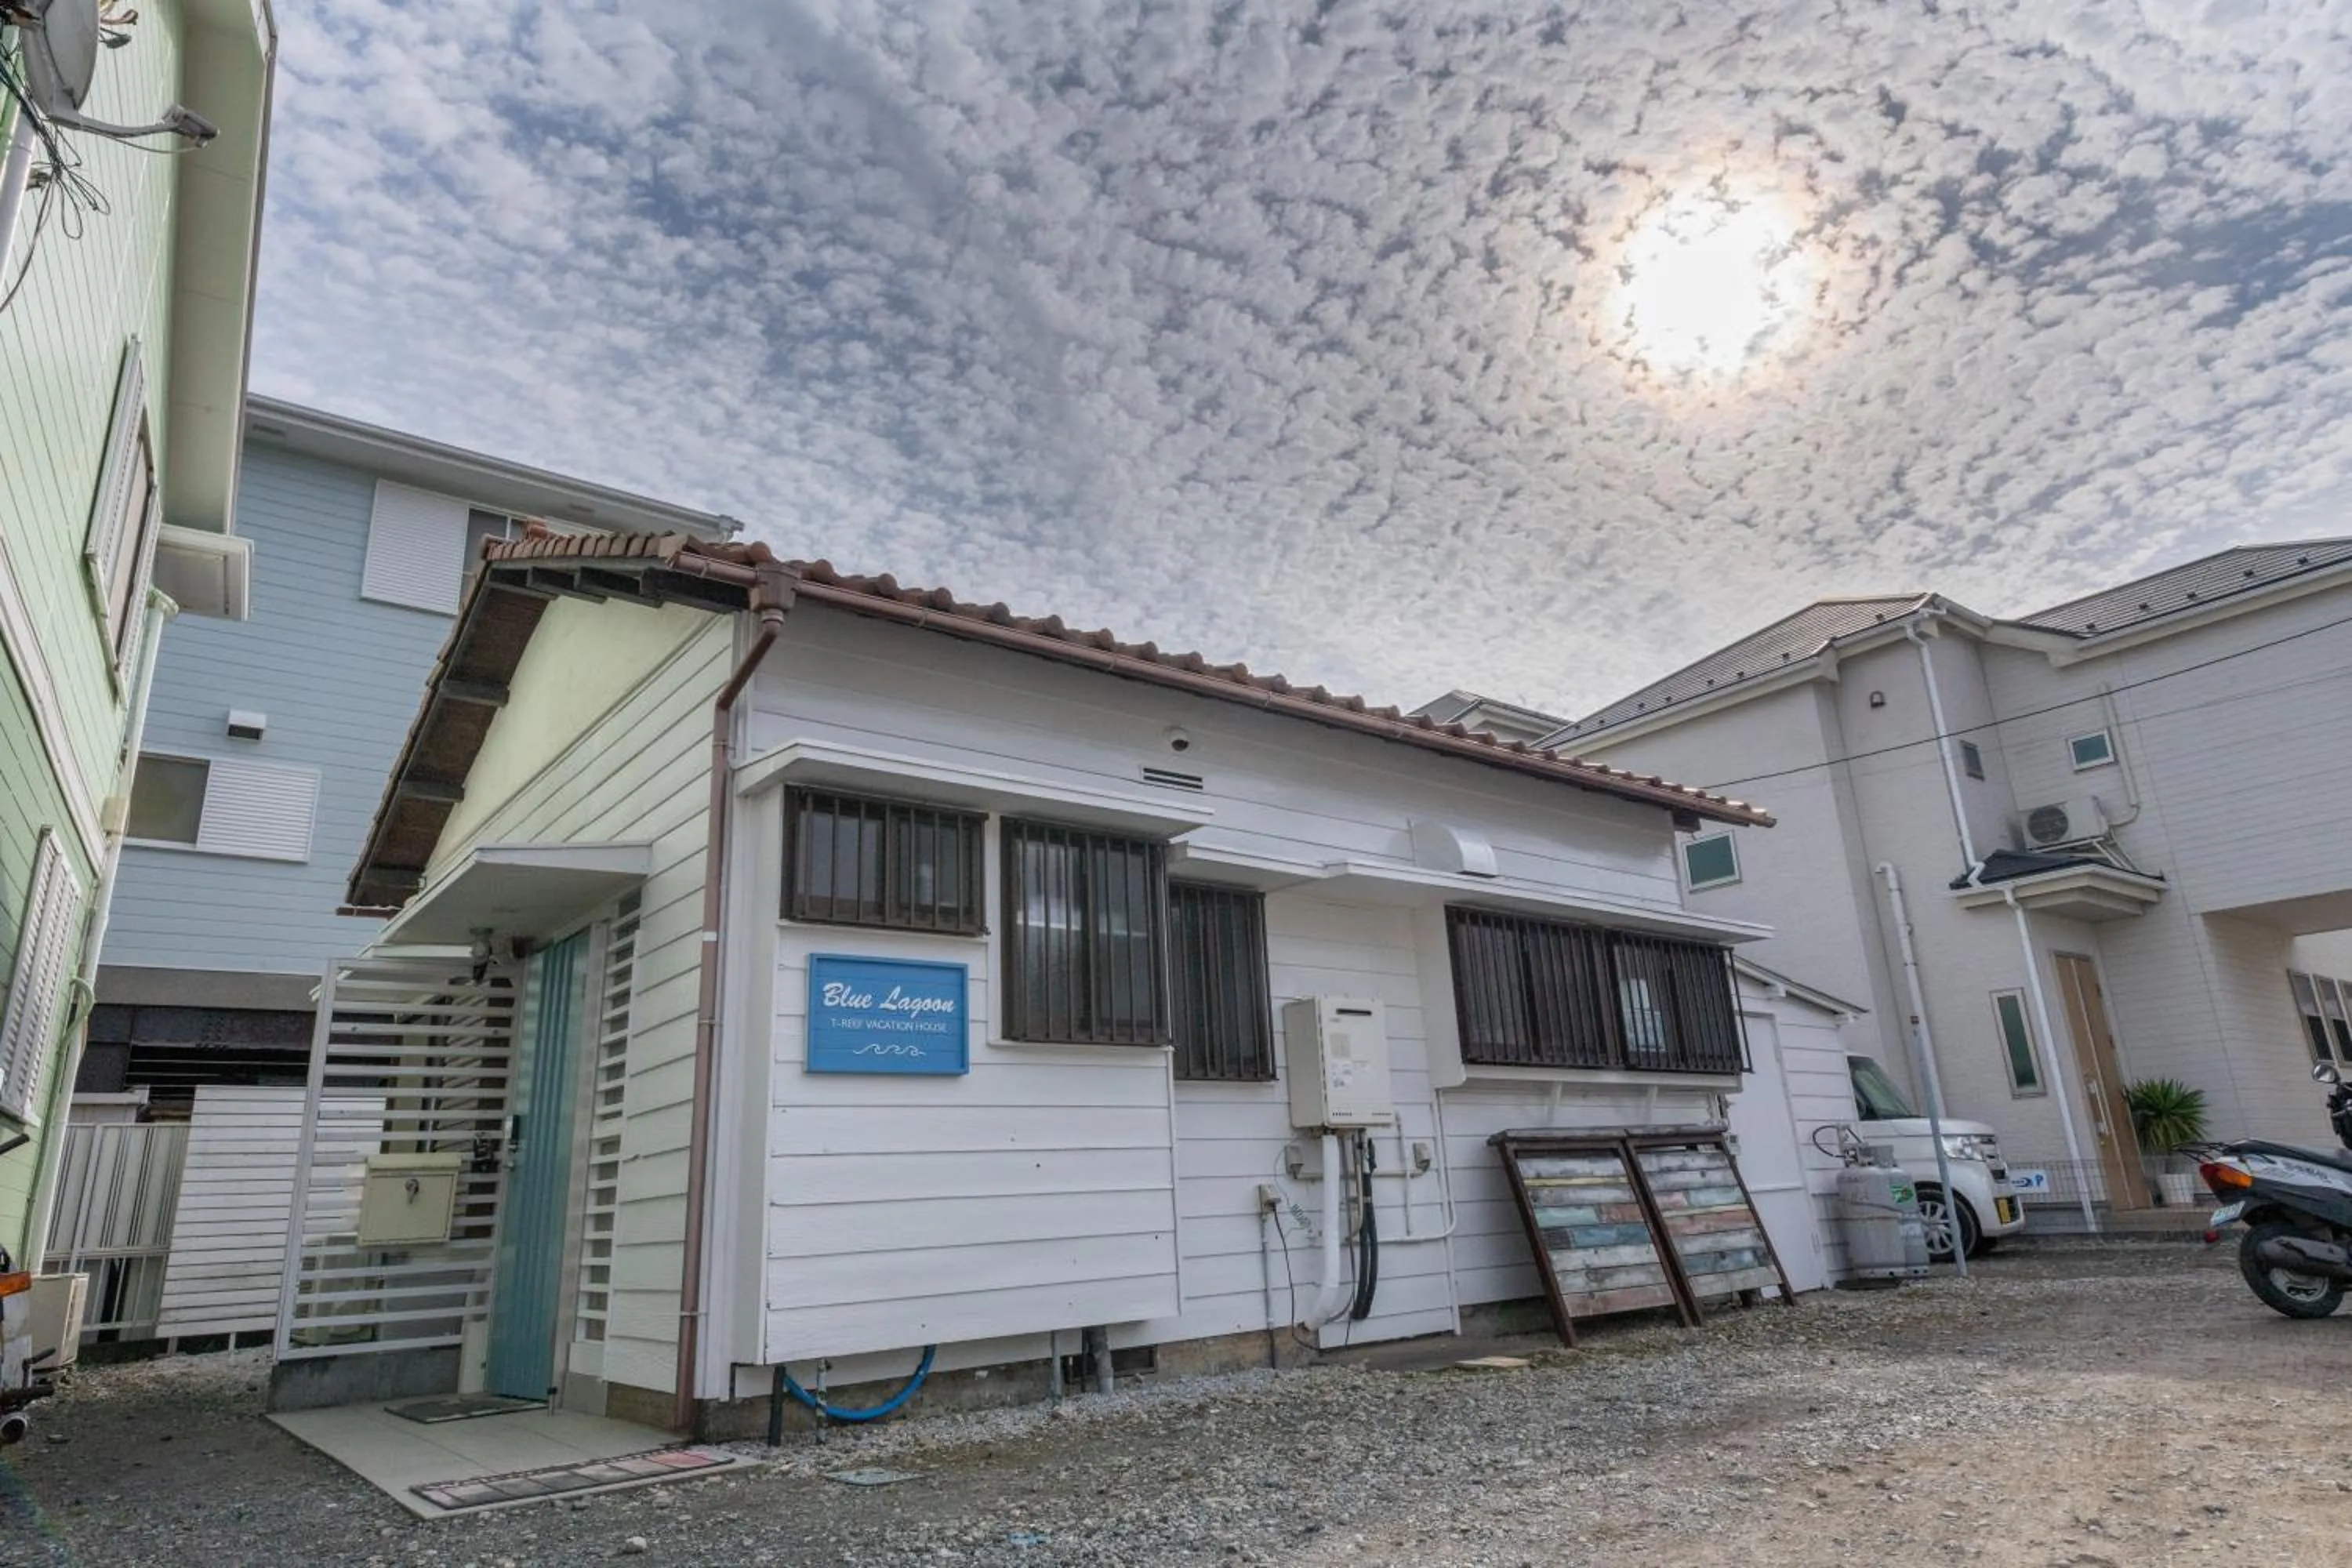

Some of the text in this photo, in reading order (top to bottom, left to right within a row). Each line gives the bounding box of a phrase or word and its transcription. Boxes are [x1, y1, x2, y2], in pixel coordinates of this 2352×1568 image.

[822, 982, 954, 1019] Blue Lagoon
[866, 1019, 913, 1032] VACATION
[916, 1022, 948, 1033] HOUSE
